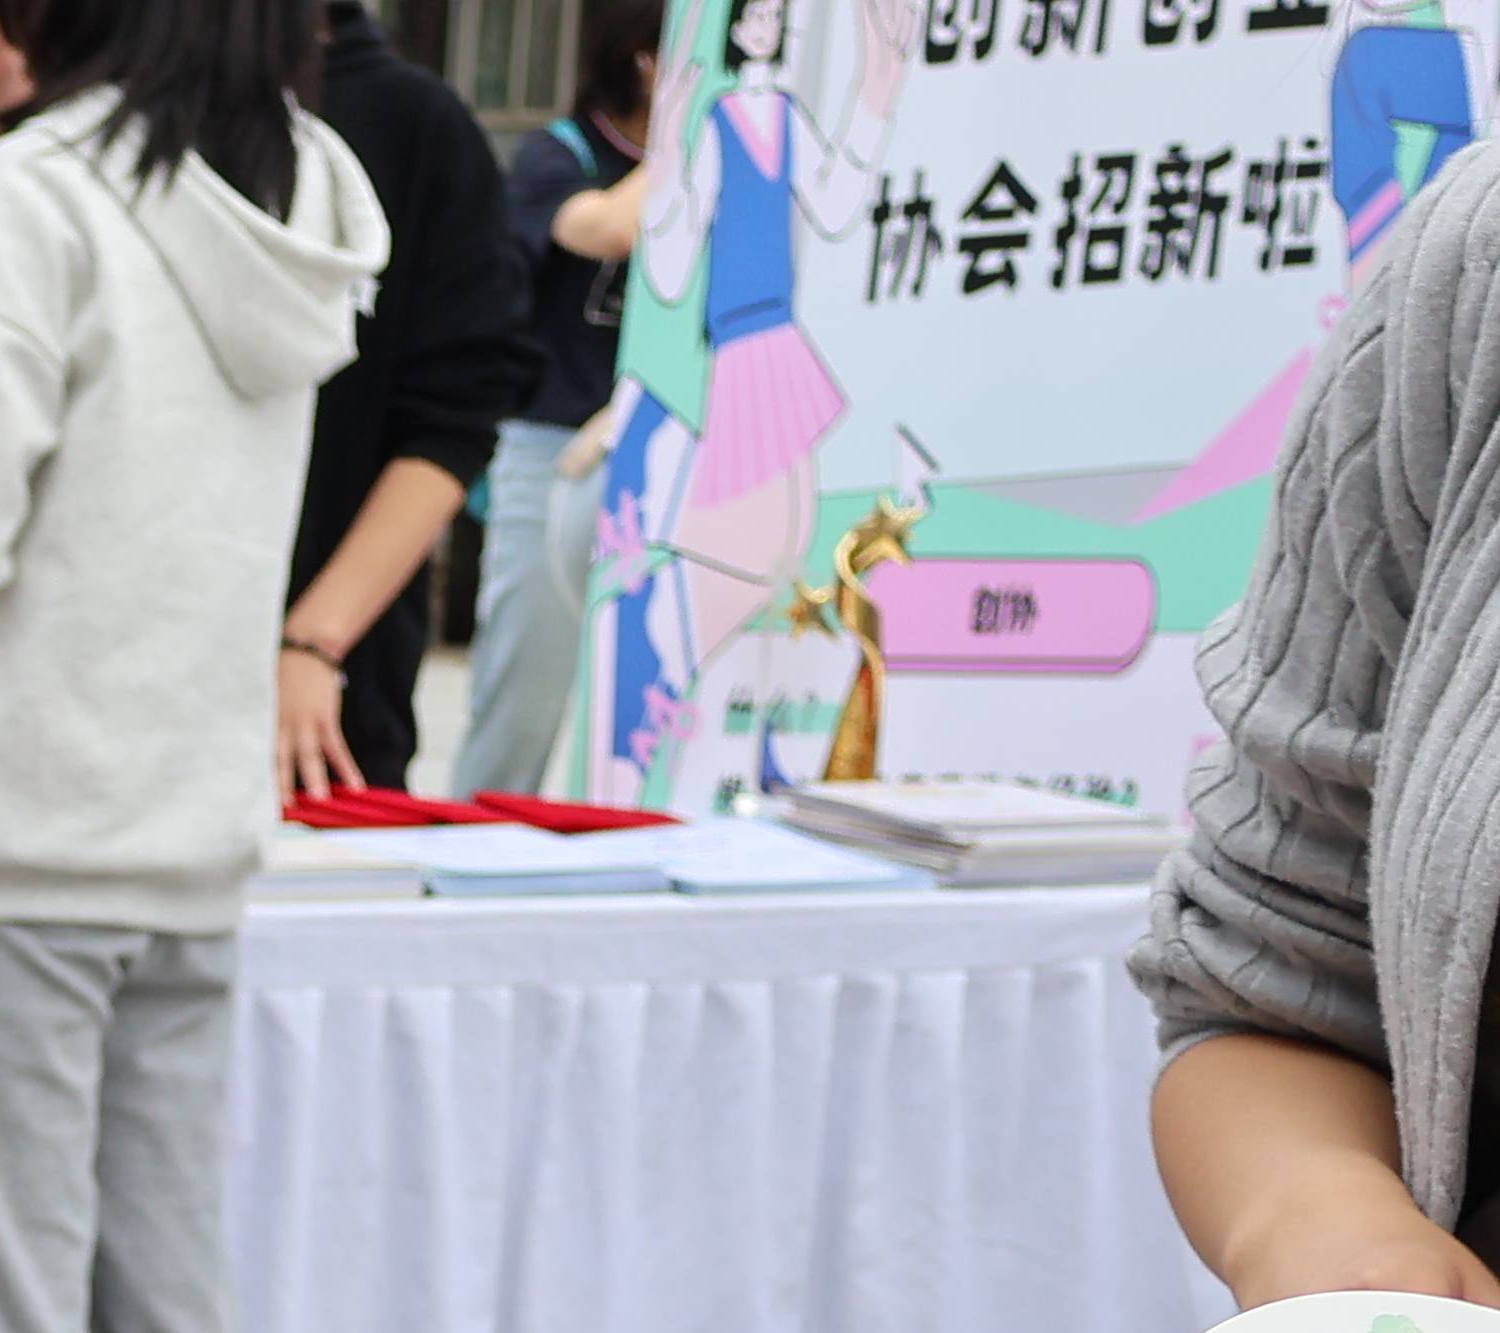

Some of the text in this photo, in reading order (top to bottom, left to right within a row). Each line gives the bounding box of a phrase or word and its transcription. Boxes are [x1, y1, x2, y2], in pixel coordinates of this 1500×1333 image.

[869, 139, 1328, 301] 协会招新啦
